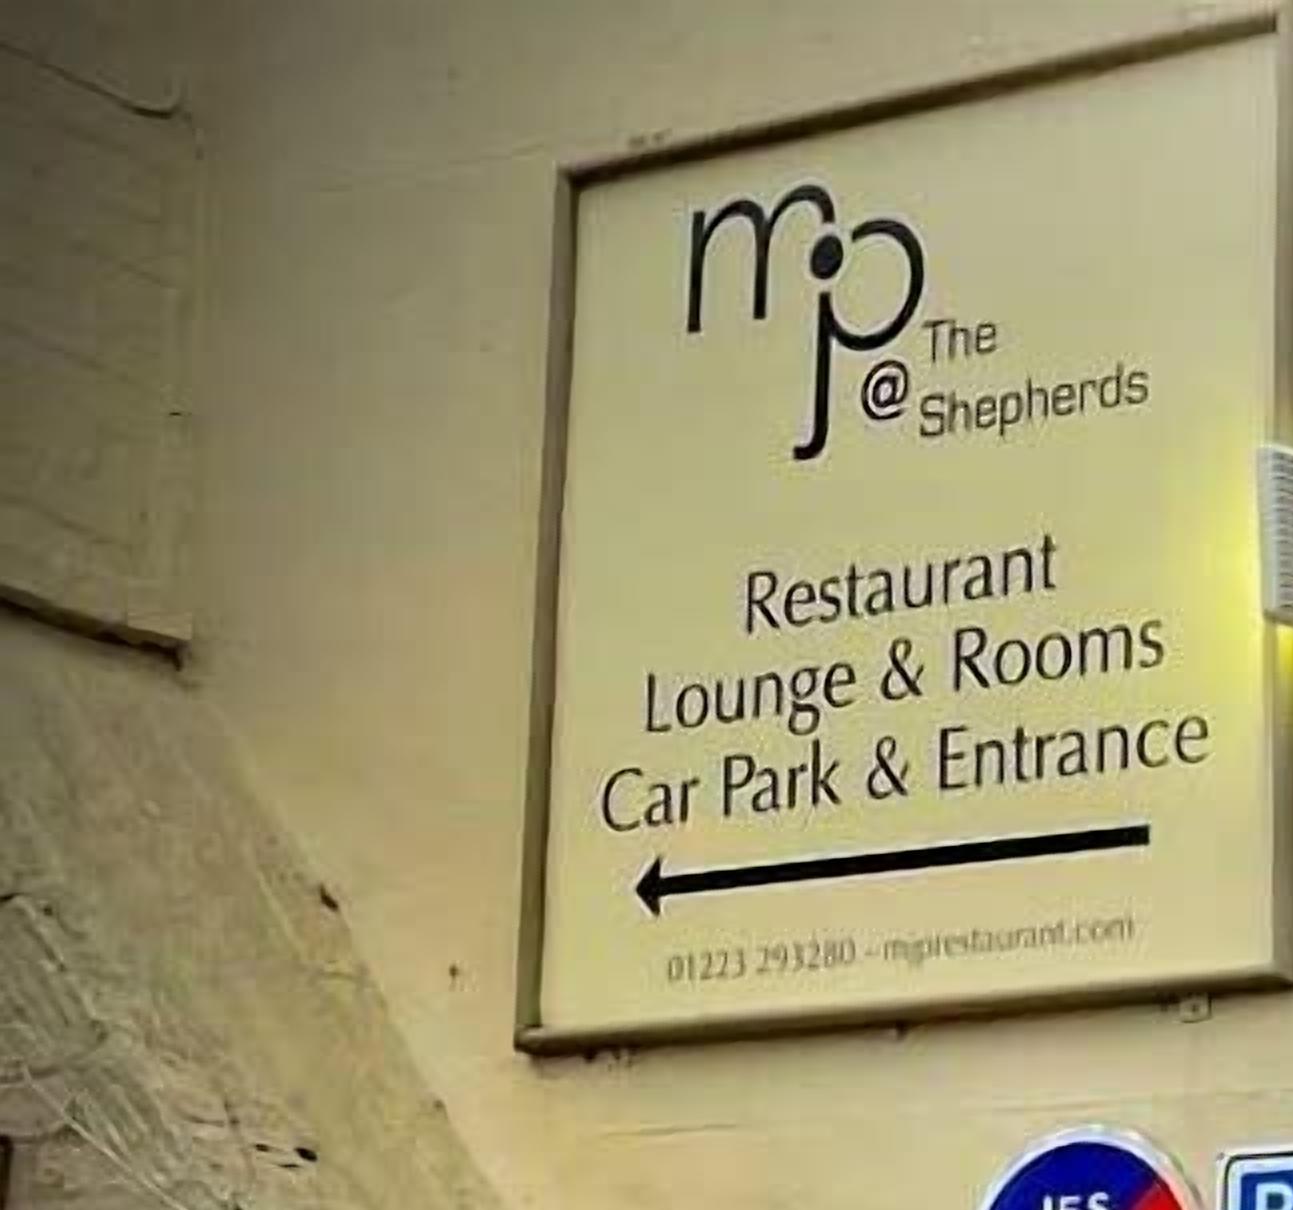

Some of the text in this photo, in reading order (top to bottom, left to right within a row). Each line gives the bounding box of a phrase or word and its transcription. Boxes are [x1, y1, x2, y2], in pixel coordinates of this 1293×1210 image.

[921, 318, 999, 364] The
[861, 358, 1150, 440] @ Shepherds
[743, 533, 1058, 635] Restaurant
[644, 618, 1166, 736] Lounge & Rooms
[600, 713, 1211, 832] Car Park & Entrance
[667, 947, 746, 984] 01223
